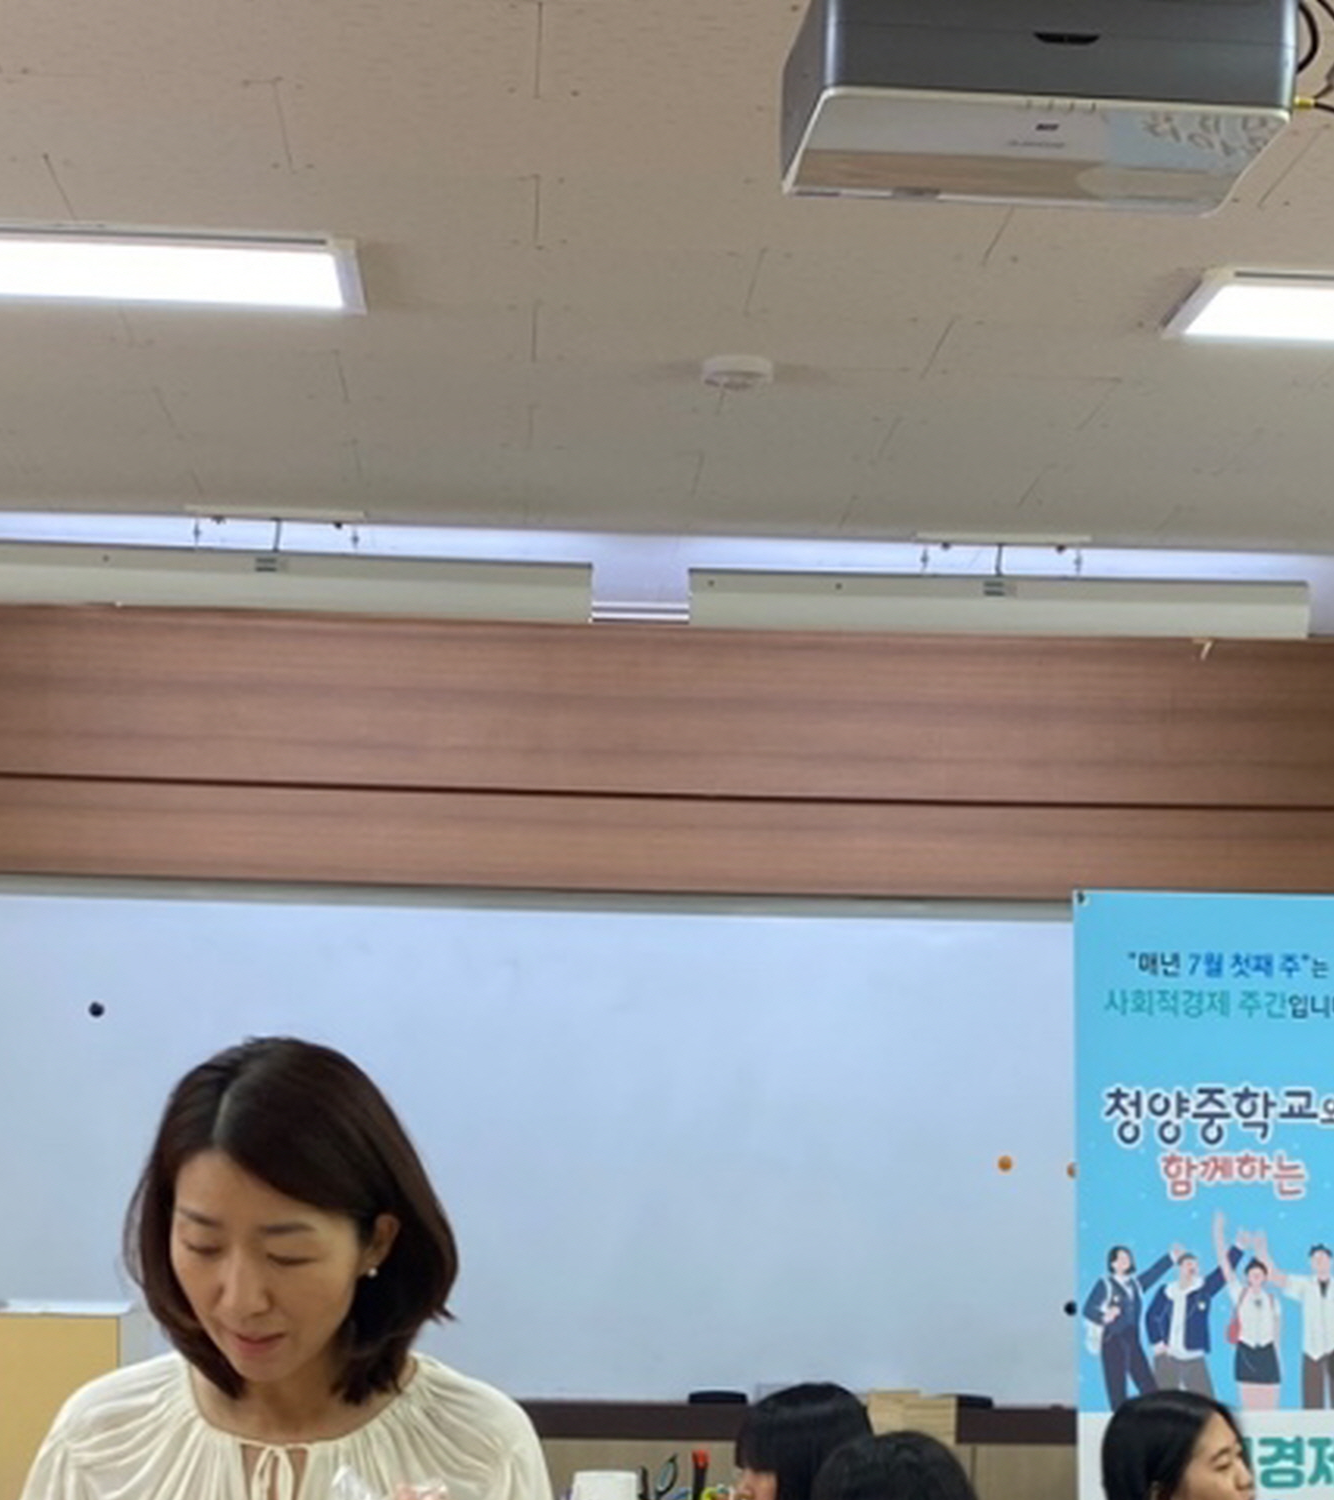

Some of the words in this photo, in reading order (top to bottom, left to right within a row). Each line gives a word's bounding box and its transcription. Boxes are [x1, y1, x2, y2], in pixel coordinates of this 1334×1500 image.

[1188, 953, 1224, 978] 7월
[1230, 953, 1274, 978] 첫째
[1104, 988, 1230, 1019] 사회적경제
[1160, 1152, 1306, 1198] 함께하는
